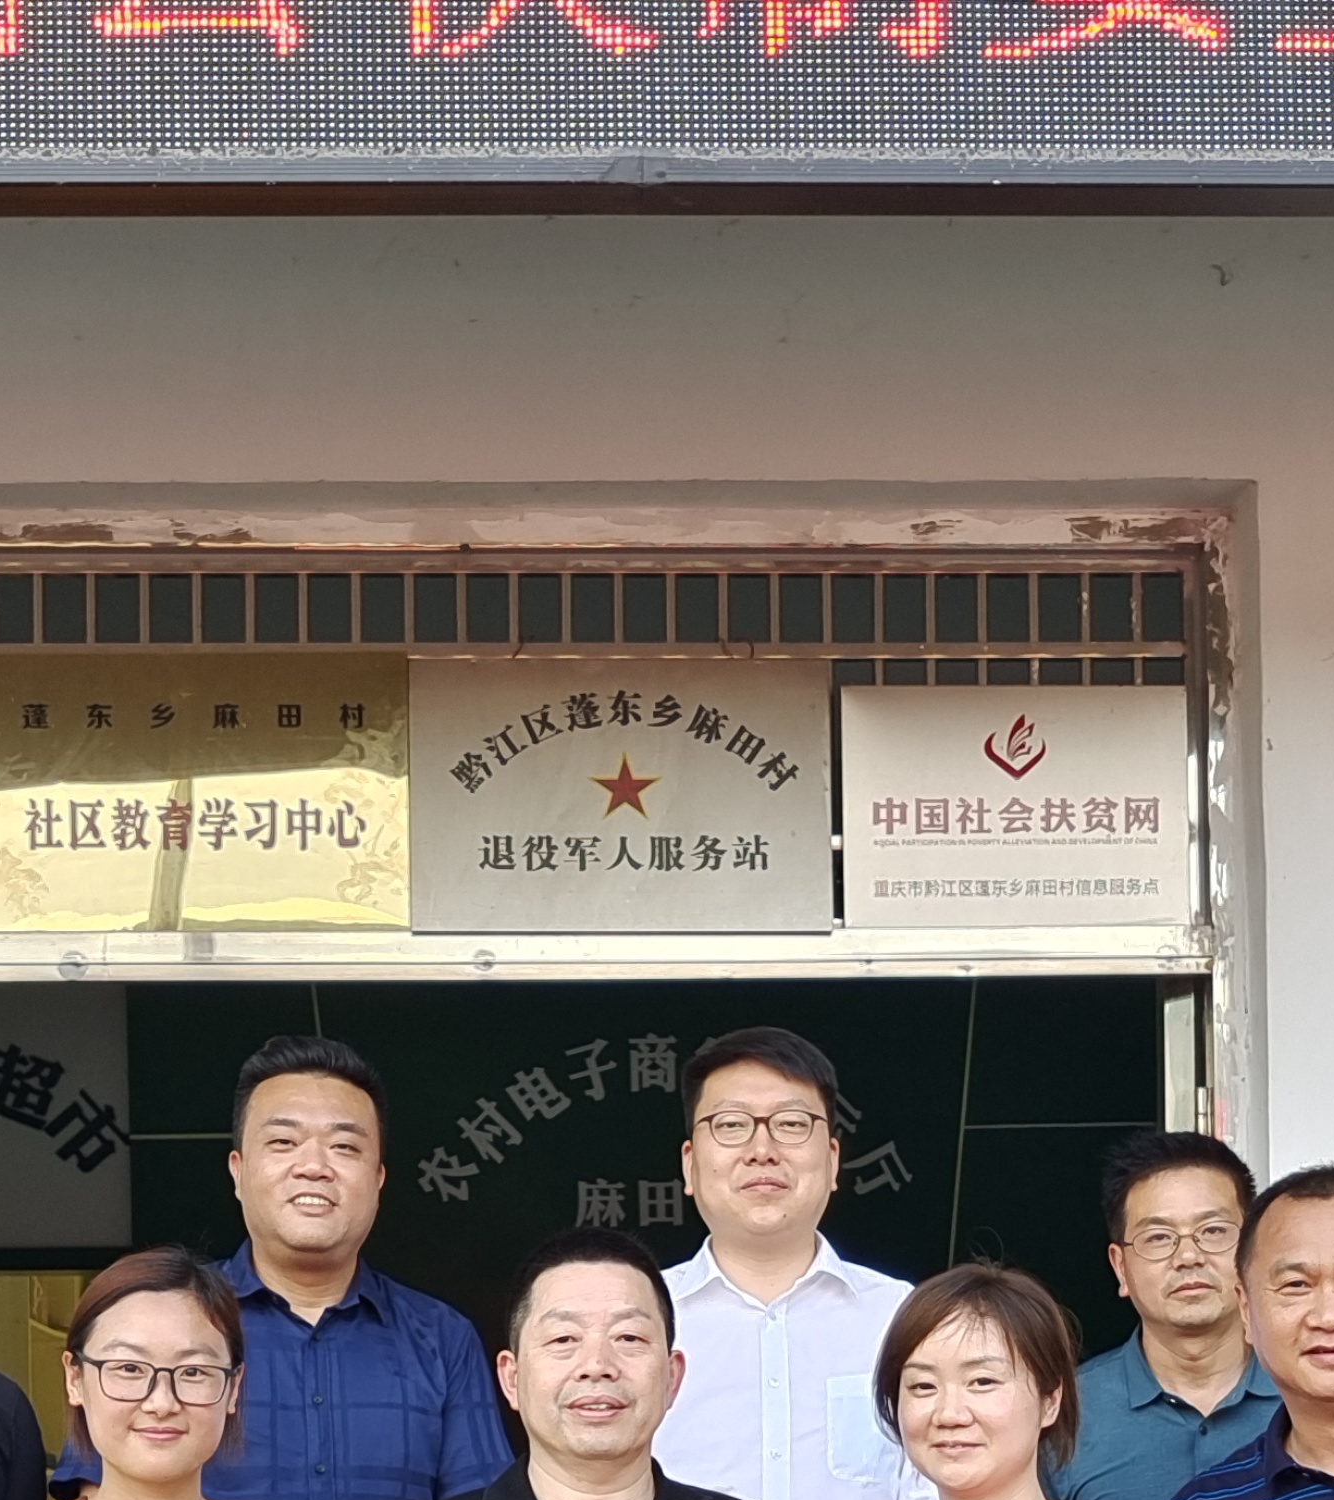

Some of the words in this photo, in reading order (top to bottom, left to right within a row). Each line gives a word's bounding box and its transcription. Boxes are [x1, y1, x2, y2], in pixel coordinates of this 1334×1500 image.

[22, 703, 366, 728] 蓬东乡麻田村
[449, 690, 800, 793] 黔江区蓬东乡麻田村
[25, 798, 366, 851] 社区教育学习中心
[873, 797, 1160, 835] 中国社会扶贫网
[479, 835, 769, 871] 退役军人服务站
[873, 878, 1159, 898] 重庆市黔江区蓬东乡麻田村信息服务点
